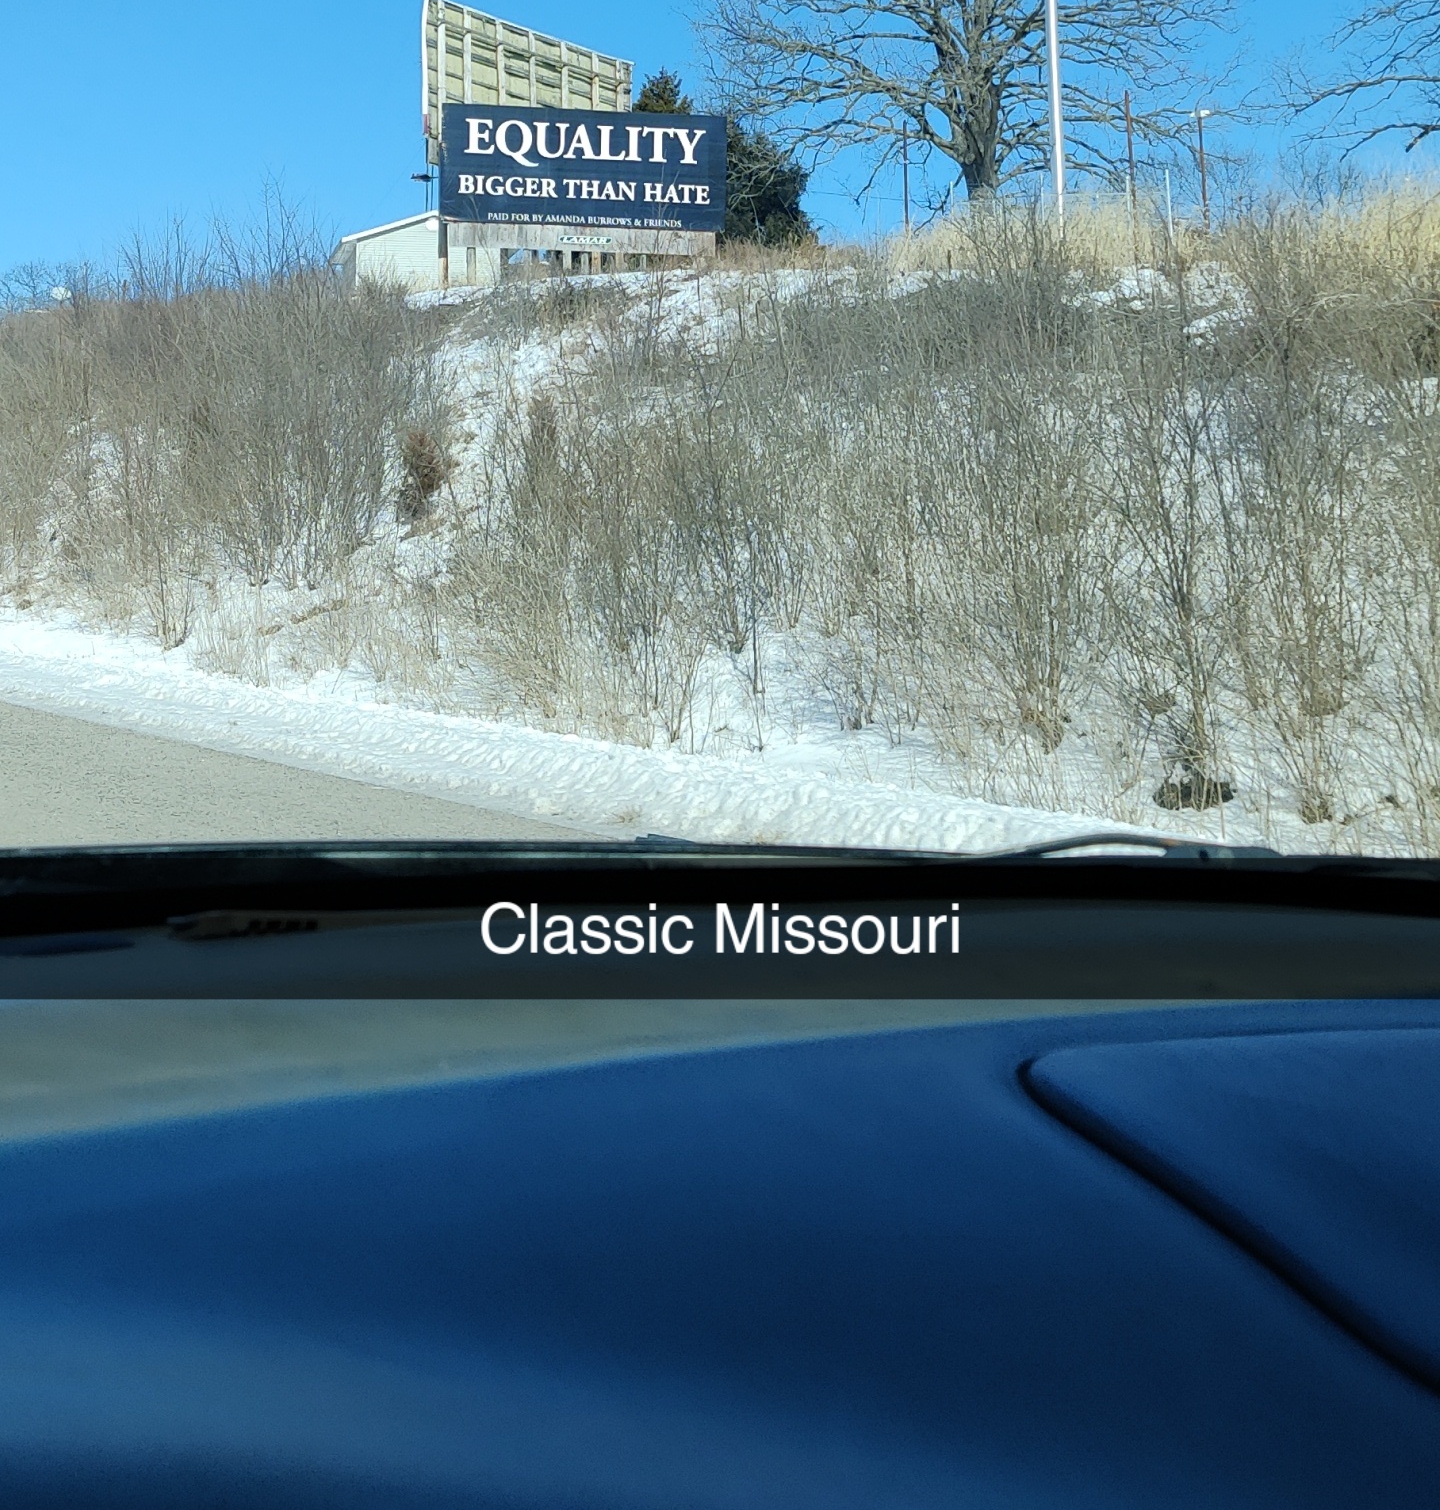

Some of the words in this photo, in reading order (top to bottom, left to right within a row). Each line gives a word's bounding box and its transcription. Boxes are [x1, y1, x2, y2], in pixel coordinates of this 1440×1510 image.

[464, 117, 707, 167] EQUALITY
[458, 174, 559, 199] BIGGER
[563, 178, 638, 202] THAN
[643, 182, 711, 205] HATE
[487, 212, 509, 221] PAID
[511, 213, 530, 222] FOR
[532, 214, 544, 222] BY
[545, 214, 586, 224] AMANDA
[587, 216, 632, 226] BURROWS
[634, 218, 642, 227] &
[643, 218, 682, 228] FRIENDS
[563, 236, 607, 244] LAMAR
